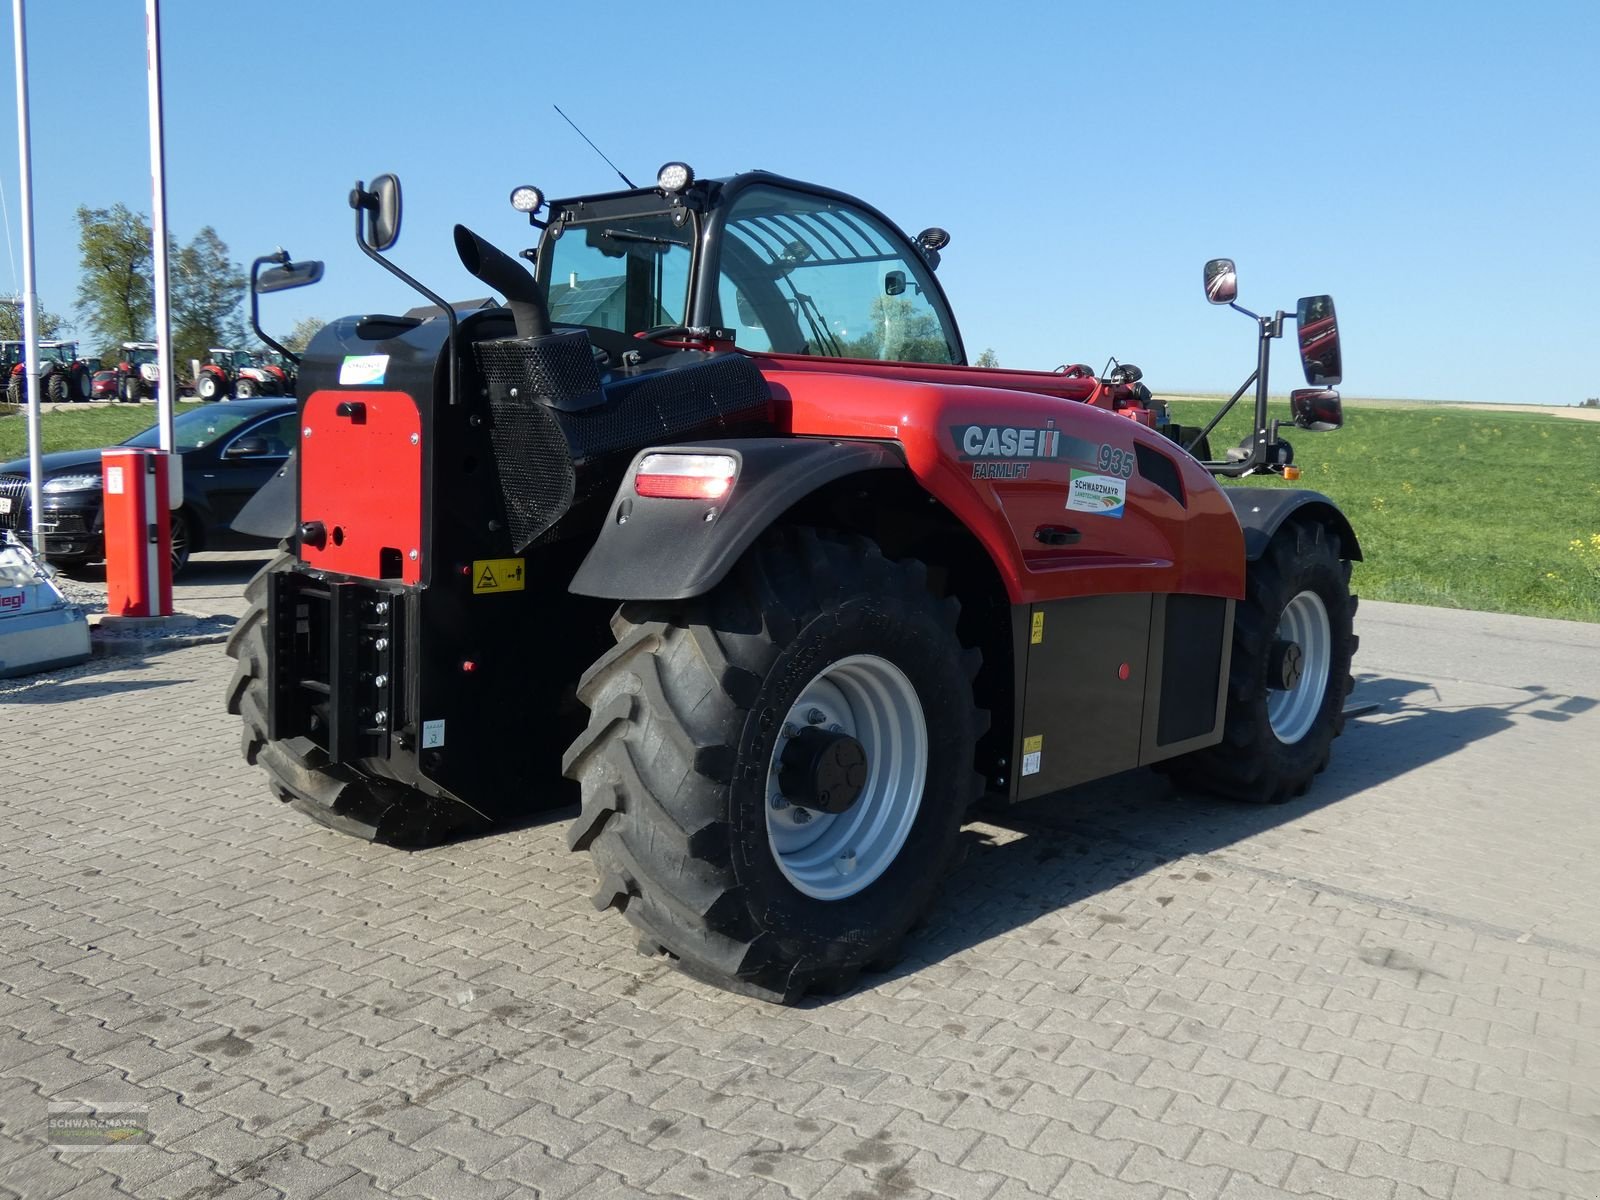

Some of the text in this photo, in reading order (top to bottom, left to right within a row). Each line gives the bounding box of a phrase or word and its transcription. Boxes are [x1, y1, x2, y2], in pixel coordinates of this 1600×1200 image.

[963, 425, 1036, 457] CASE
[972, 462, 1031, 480] FARMLIFT
[1098, 443, 1135, 479] 935
[1075, 479, 1119, 496] SCHWARZMAYR
